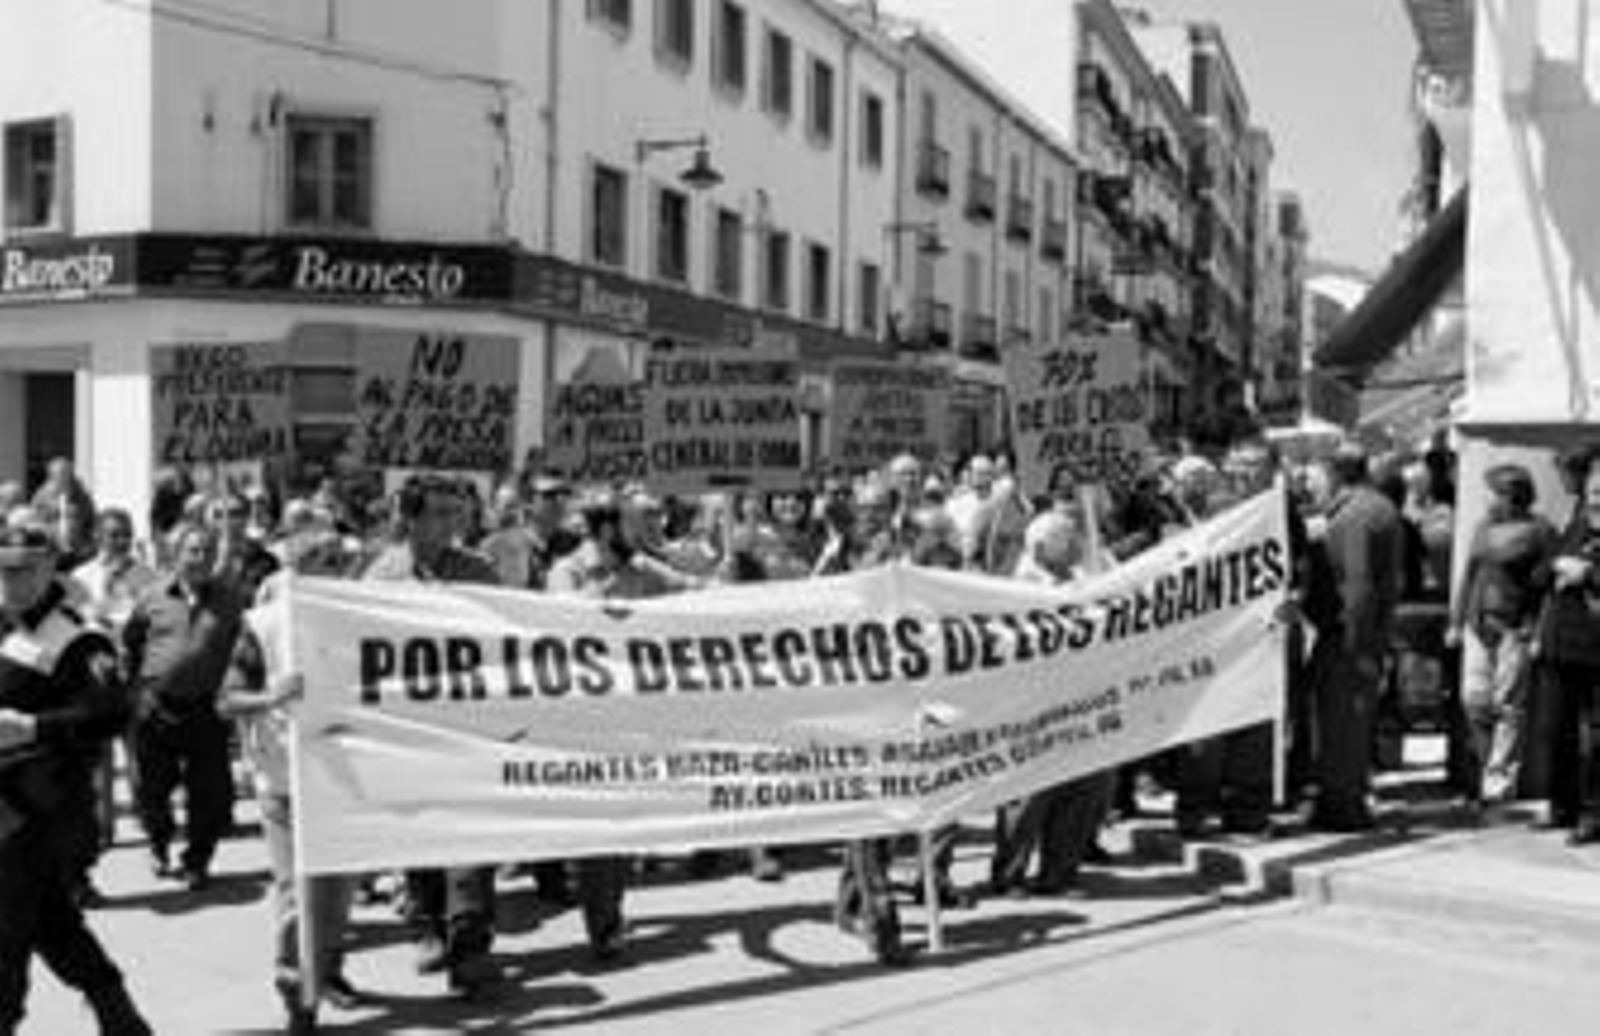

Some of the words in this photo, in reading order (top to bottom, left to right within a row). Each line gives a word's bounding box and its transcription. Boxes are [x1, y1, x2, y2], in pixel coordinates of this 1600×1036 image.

[2, 247, 113, 290] Banesto
[296, 247, 464, 295] Banesto
[411, 333, 465, 377] NO
[174, 400, 253, 431] PARA
[700, 398, 725, 424] LA
[360, 637, 488, 704] POR
[502, 635, 613, 698] LOS
[626, 616, 931, 694] DERECHOS
[943, 613, 1006, 675] DE
[1008, 604, 1096, 663] LOS
[1103, 537, 1285, 642] REGANTES
[503, 755, 660, 786] REGANTES
